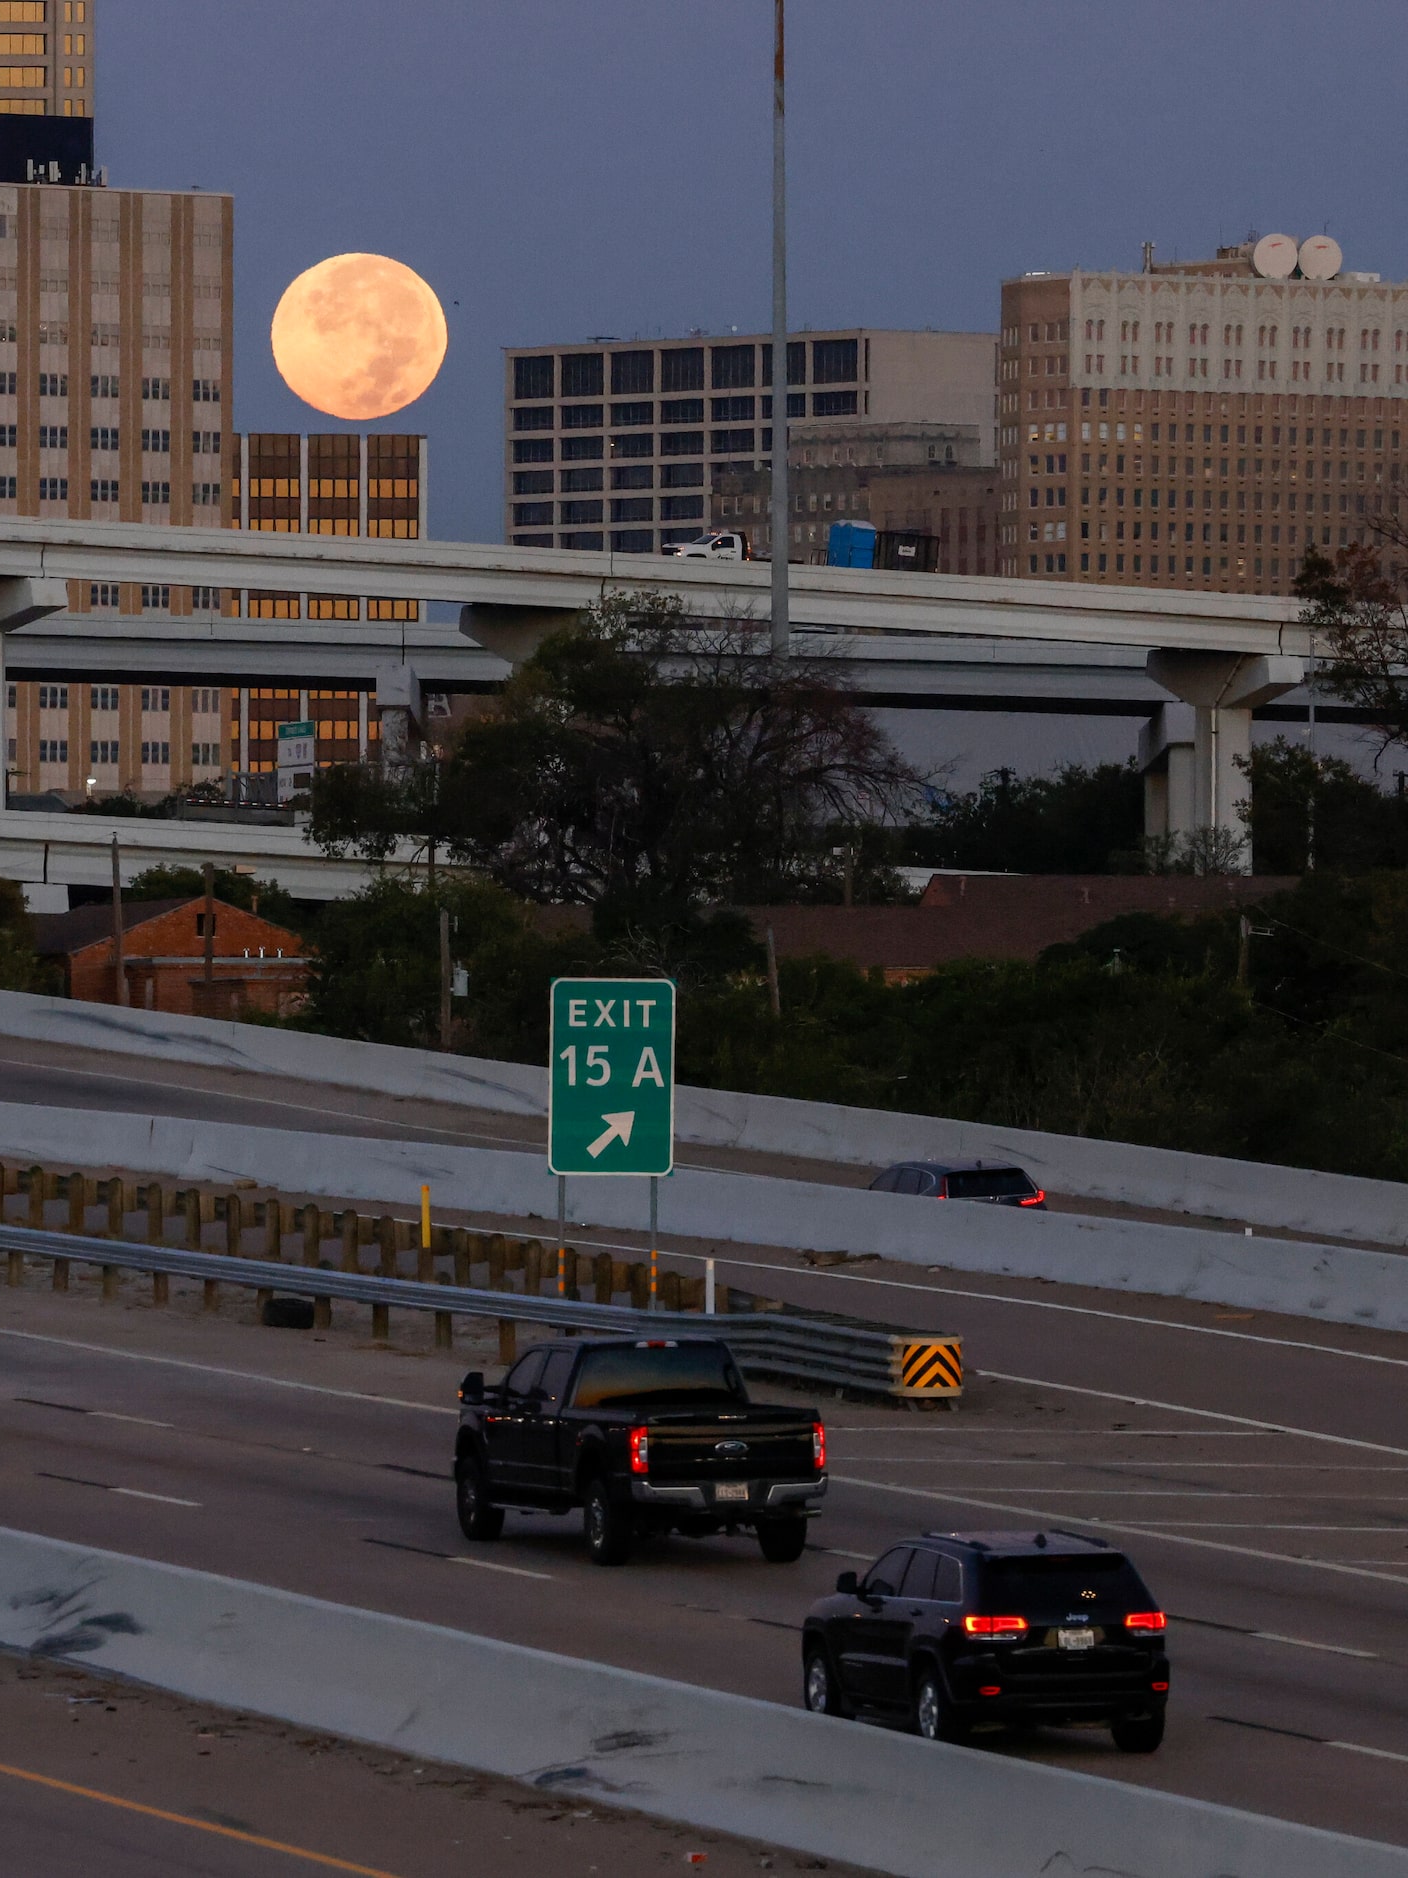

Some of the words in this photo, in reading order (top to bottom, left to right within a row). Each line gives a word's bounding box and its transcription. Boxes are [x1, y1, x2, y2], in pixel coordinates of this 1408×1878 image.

[568, 999, 657, 1028] EXIT
[559, 1045, 612, 1087] 15
[631, 1046, 665, 1088] A
[1065, 1611, 1089, 1623] Jeep
